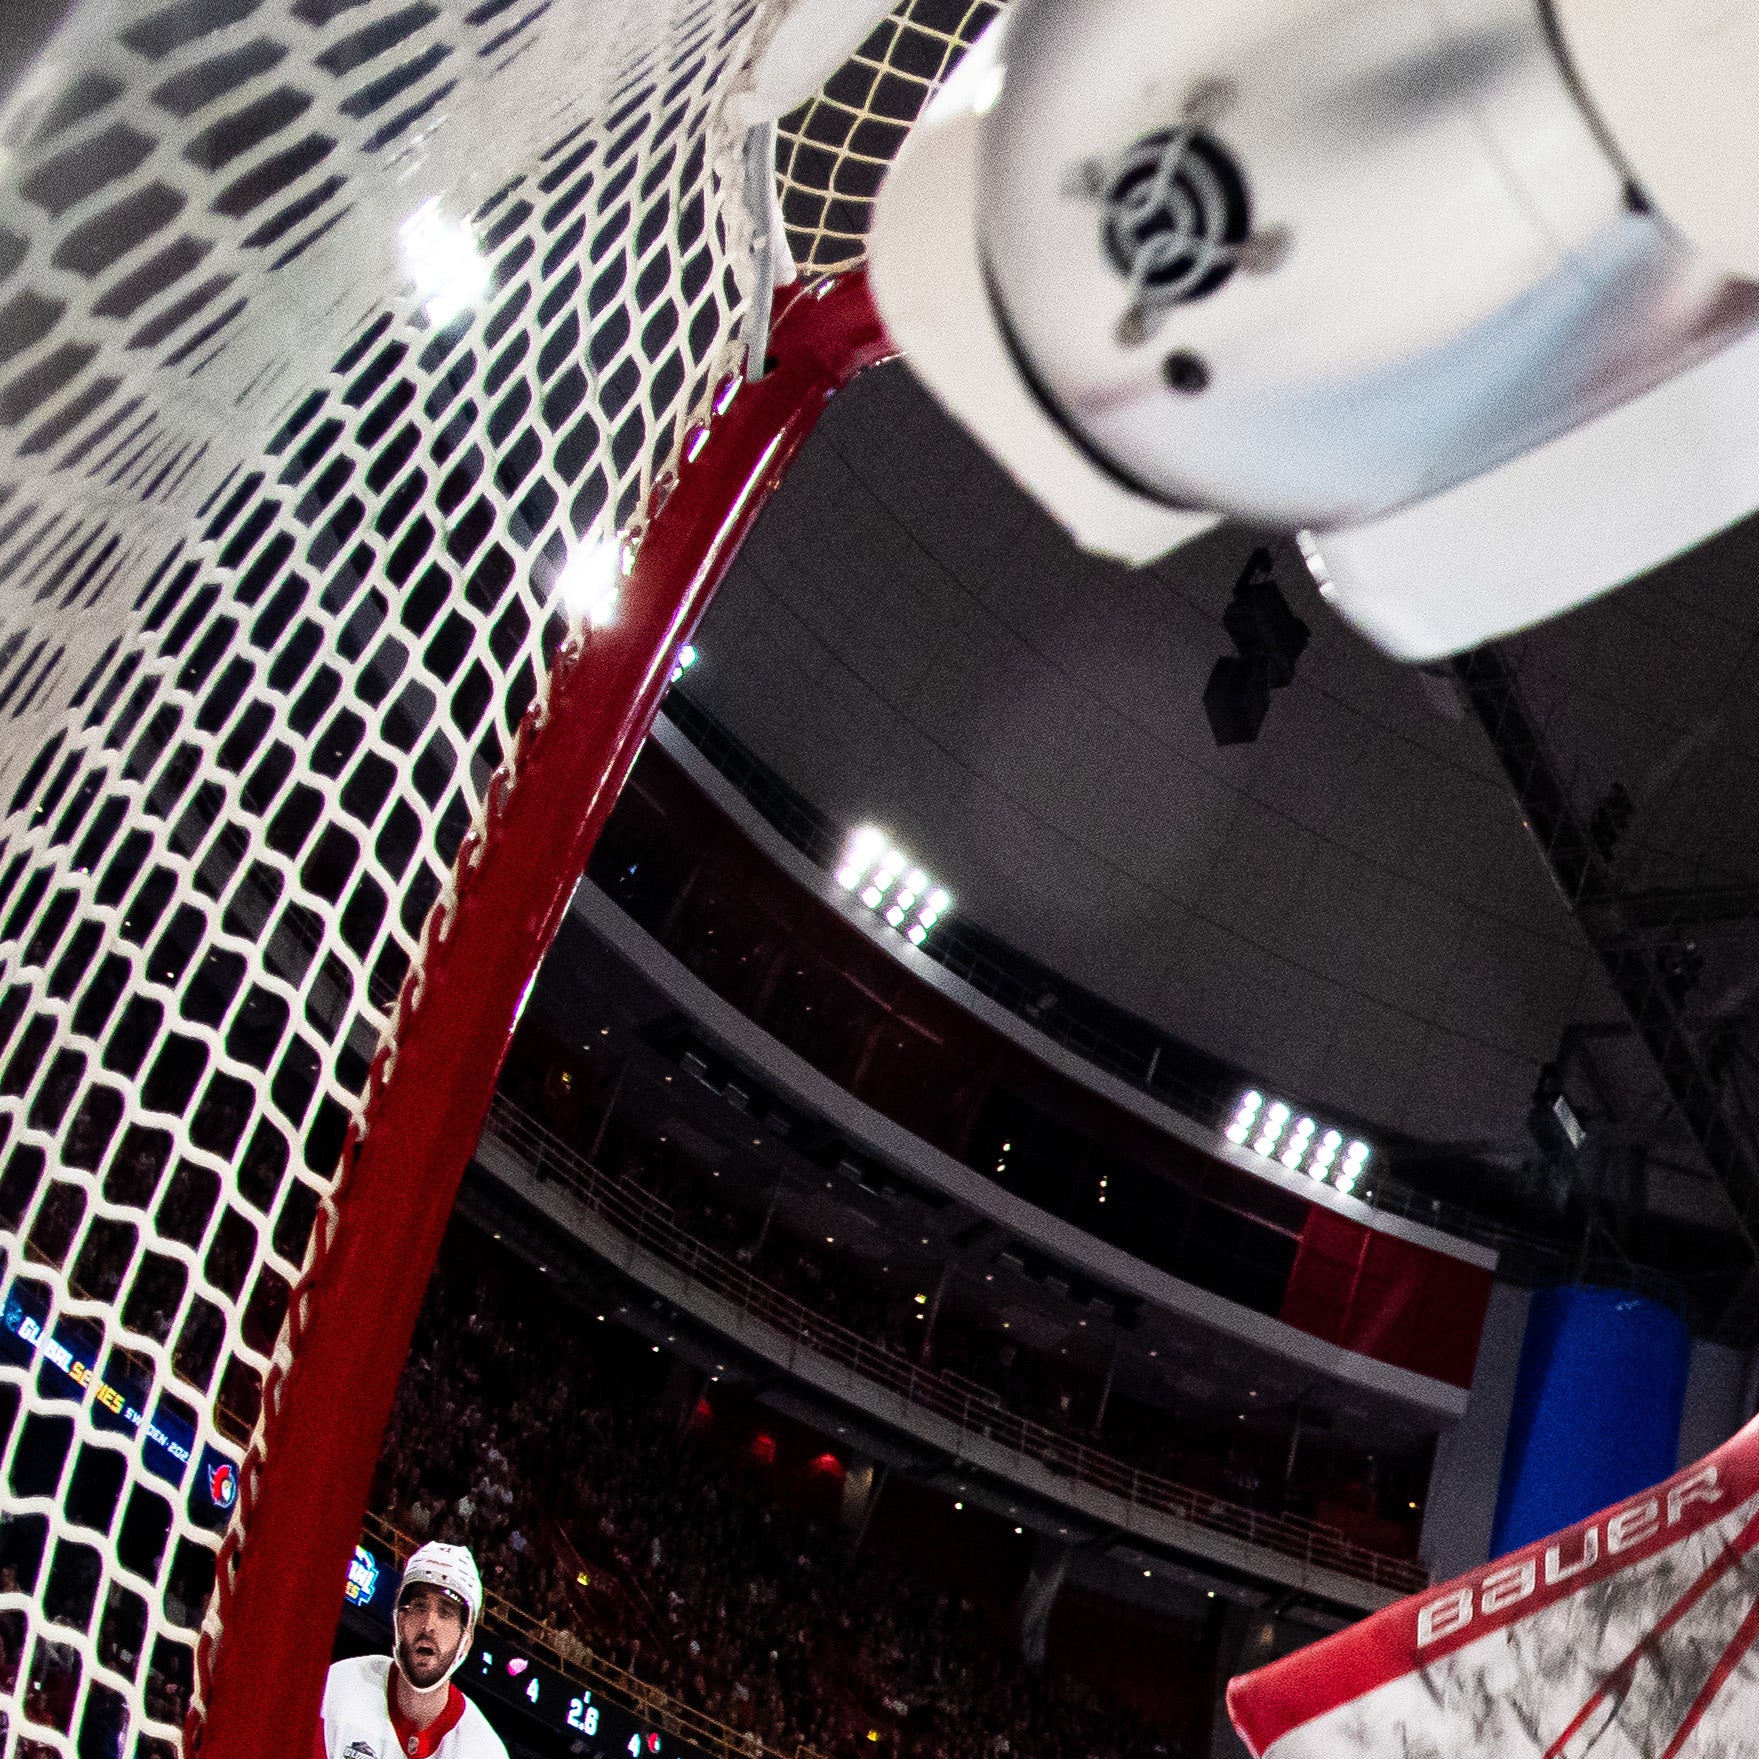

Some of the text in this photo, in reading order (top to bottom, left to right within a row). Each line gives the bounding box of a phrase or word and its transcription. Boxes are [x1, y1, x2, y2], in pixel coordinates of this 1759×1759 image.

[17, 1316, 74, 1373] GLBAL
[68, 1361, 126, 1415] SEIES
[125, 1407, 168, 1447] SWDEN
[1417, 1465, 1725, 1649] BAUER
[526, 1677, 540, 1703] 4
[567, 1697, 600, 1736] 2.6
[627, 1733, 642, 1758] 4
